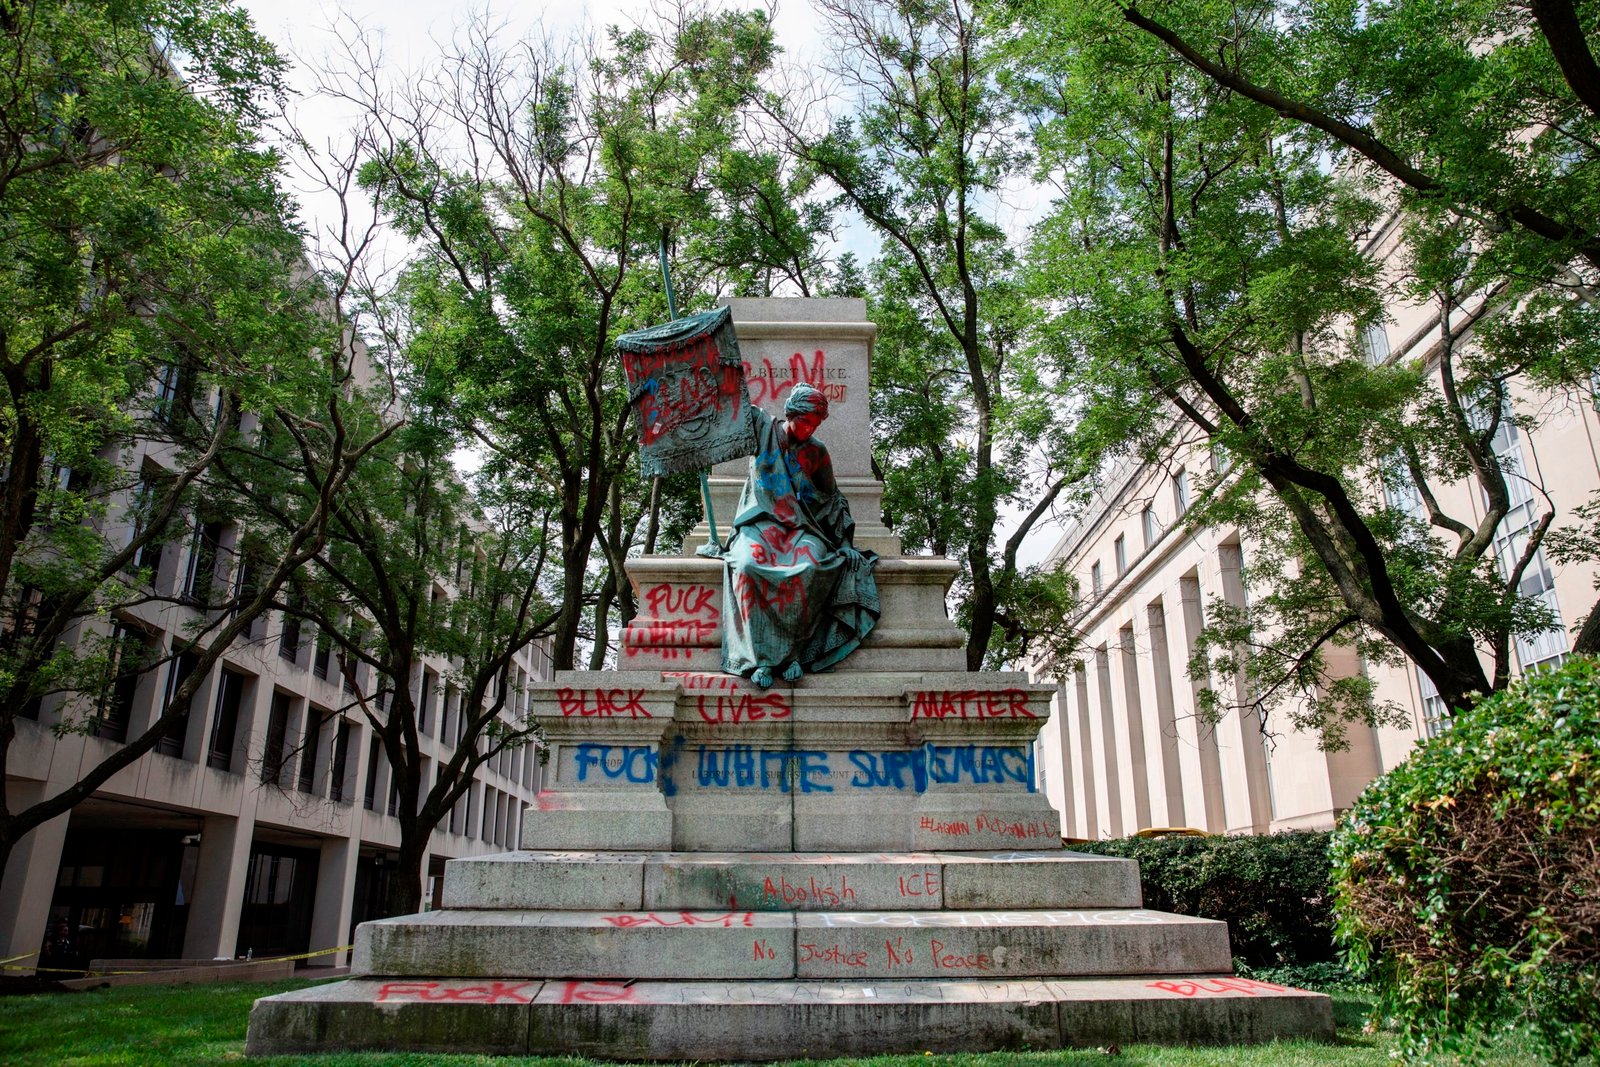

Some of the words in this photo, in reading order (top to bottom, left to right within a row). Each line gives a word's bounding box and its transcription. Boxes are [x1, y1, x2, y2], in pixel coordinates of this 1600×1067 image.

[741, 349, 825, 406] BLM
[747, 367, 800, 379] LBERT
[556, 687, 653, 720] BLACK
[698, 693, 792, 724] LIVES
[910, 687, 1038, 721] MATTER
[575, 737, 684, 796] FUCK
[697, 743, 834, 793] WHITE
[848, 740, 1036, 795] SUPREMACY
[763, 874, 856, 904] Abolish
[899, 872, 939, 897] ICE
[753, 939, 776, 961] No
[799, 943, 869, 968] Justice
[886, 936, 914, 969] No
[931, 939, 991, 970] Peace
